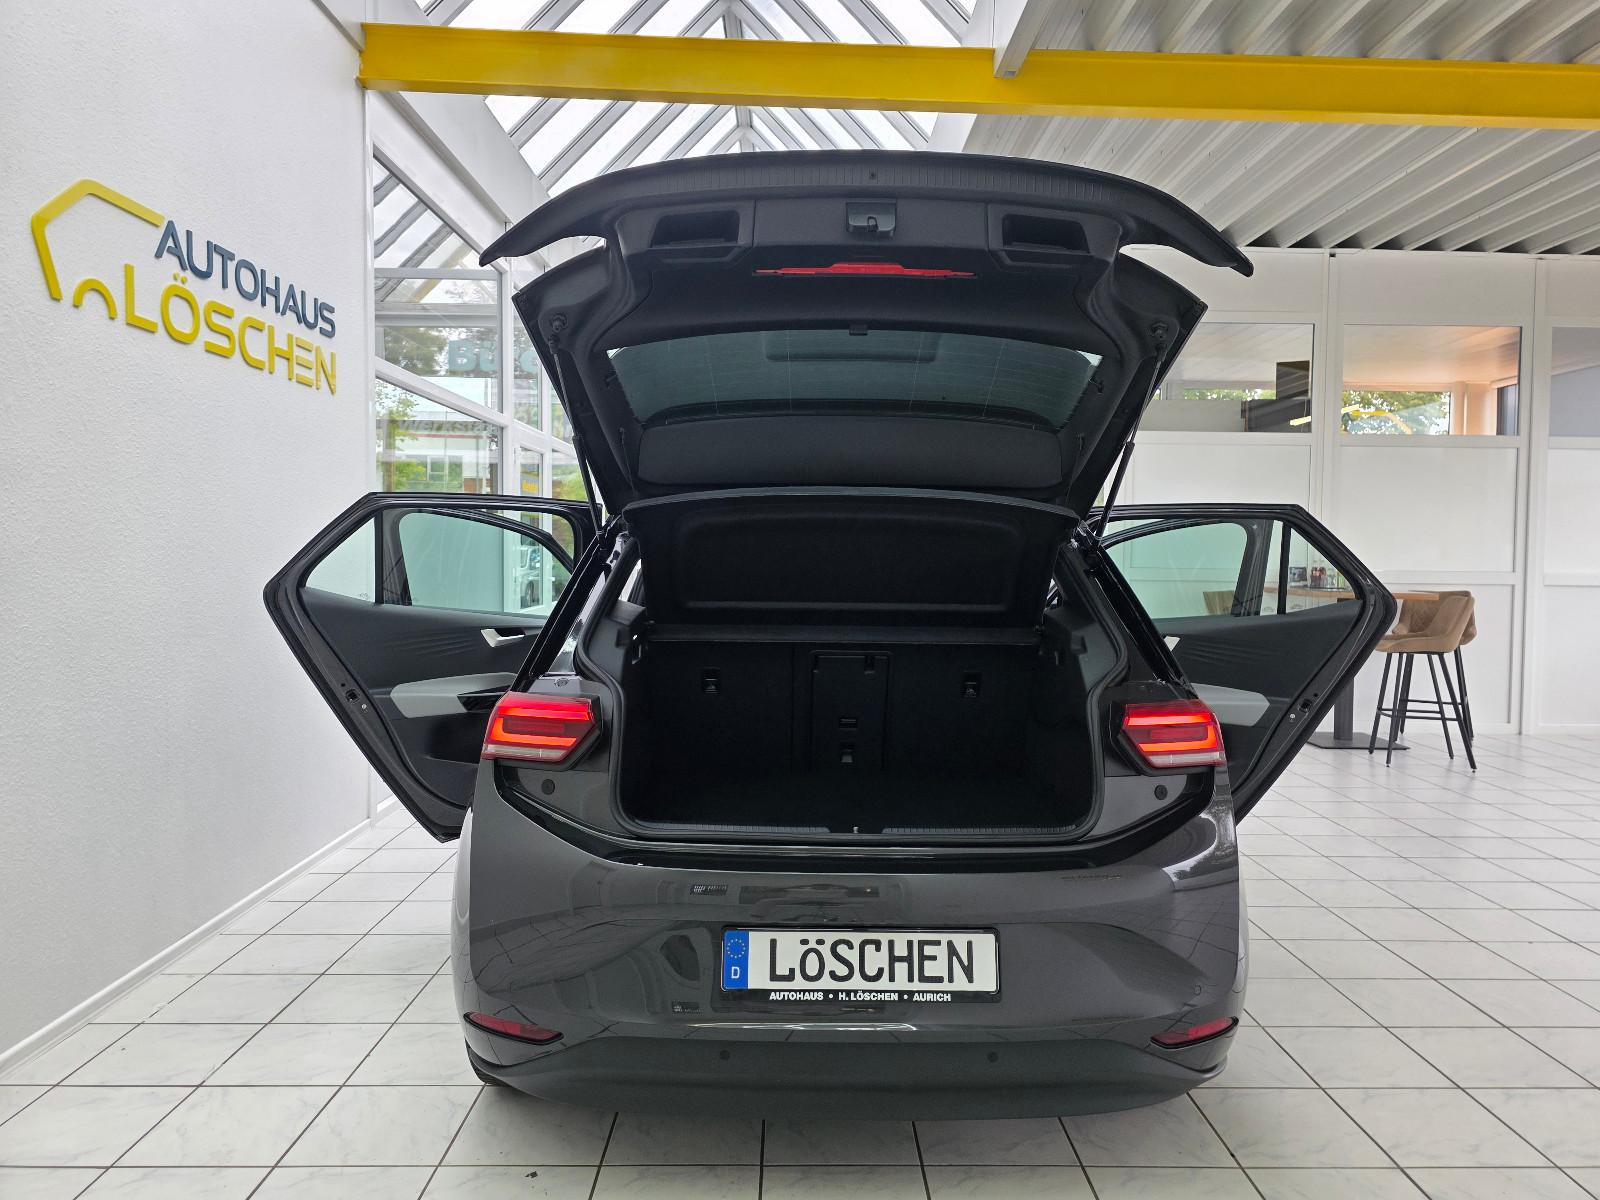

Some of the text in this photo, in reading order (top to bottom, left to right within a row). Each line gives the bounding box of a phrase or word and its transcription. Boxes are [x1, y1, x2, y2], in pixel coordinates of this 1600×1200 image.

[154, 219, 337, 339] AUTOHAUS
[123, 262, 338, 396] LÖSCHEN
[731, 966, 740, 979] D
[769, 991, 824, 1001] AUTOHAUS
[850, 990, 899, 1002] LÖSCHEN
[912, 992, 951, 1002] AURICH
